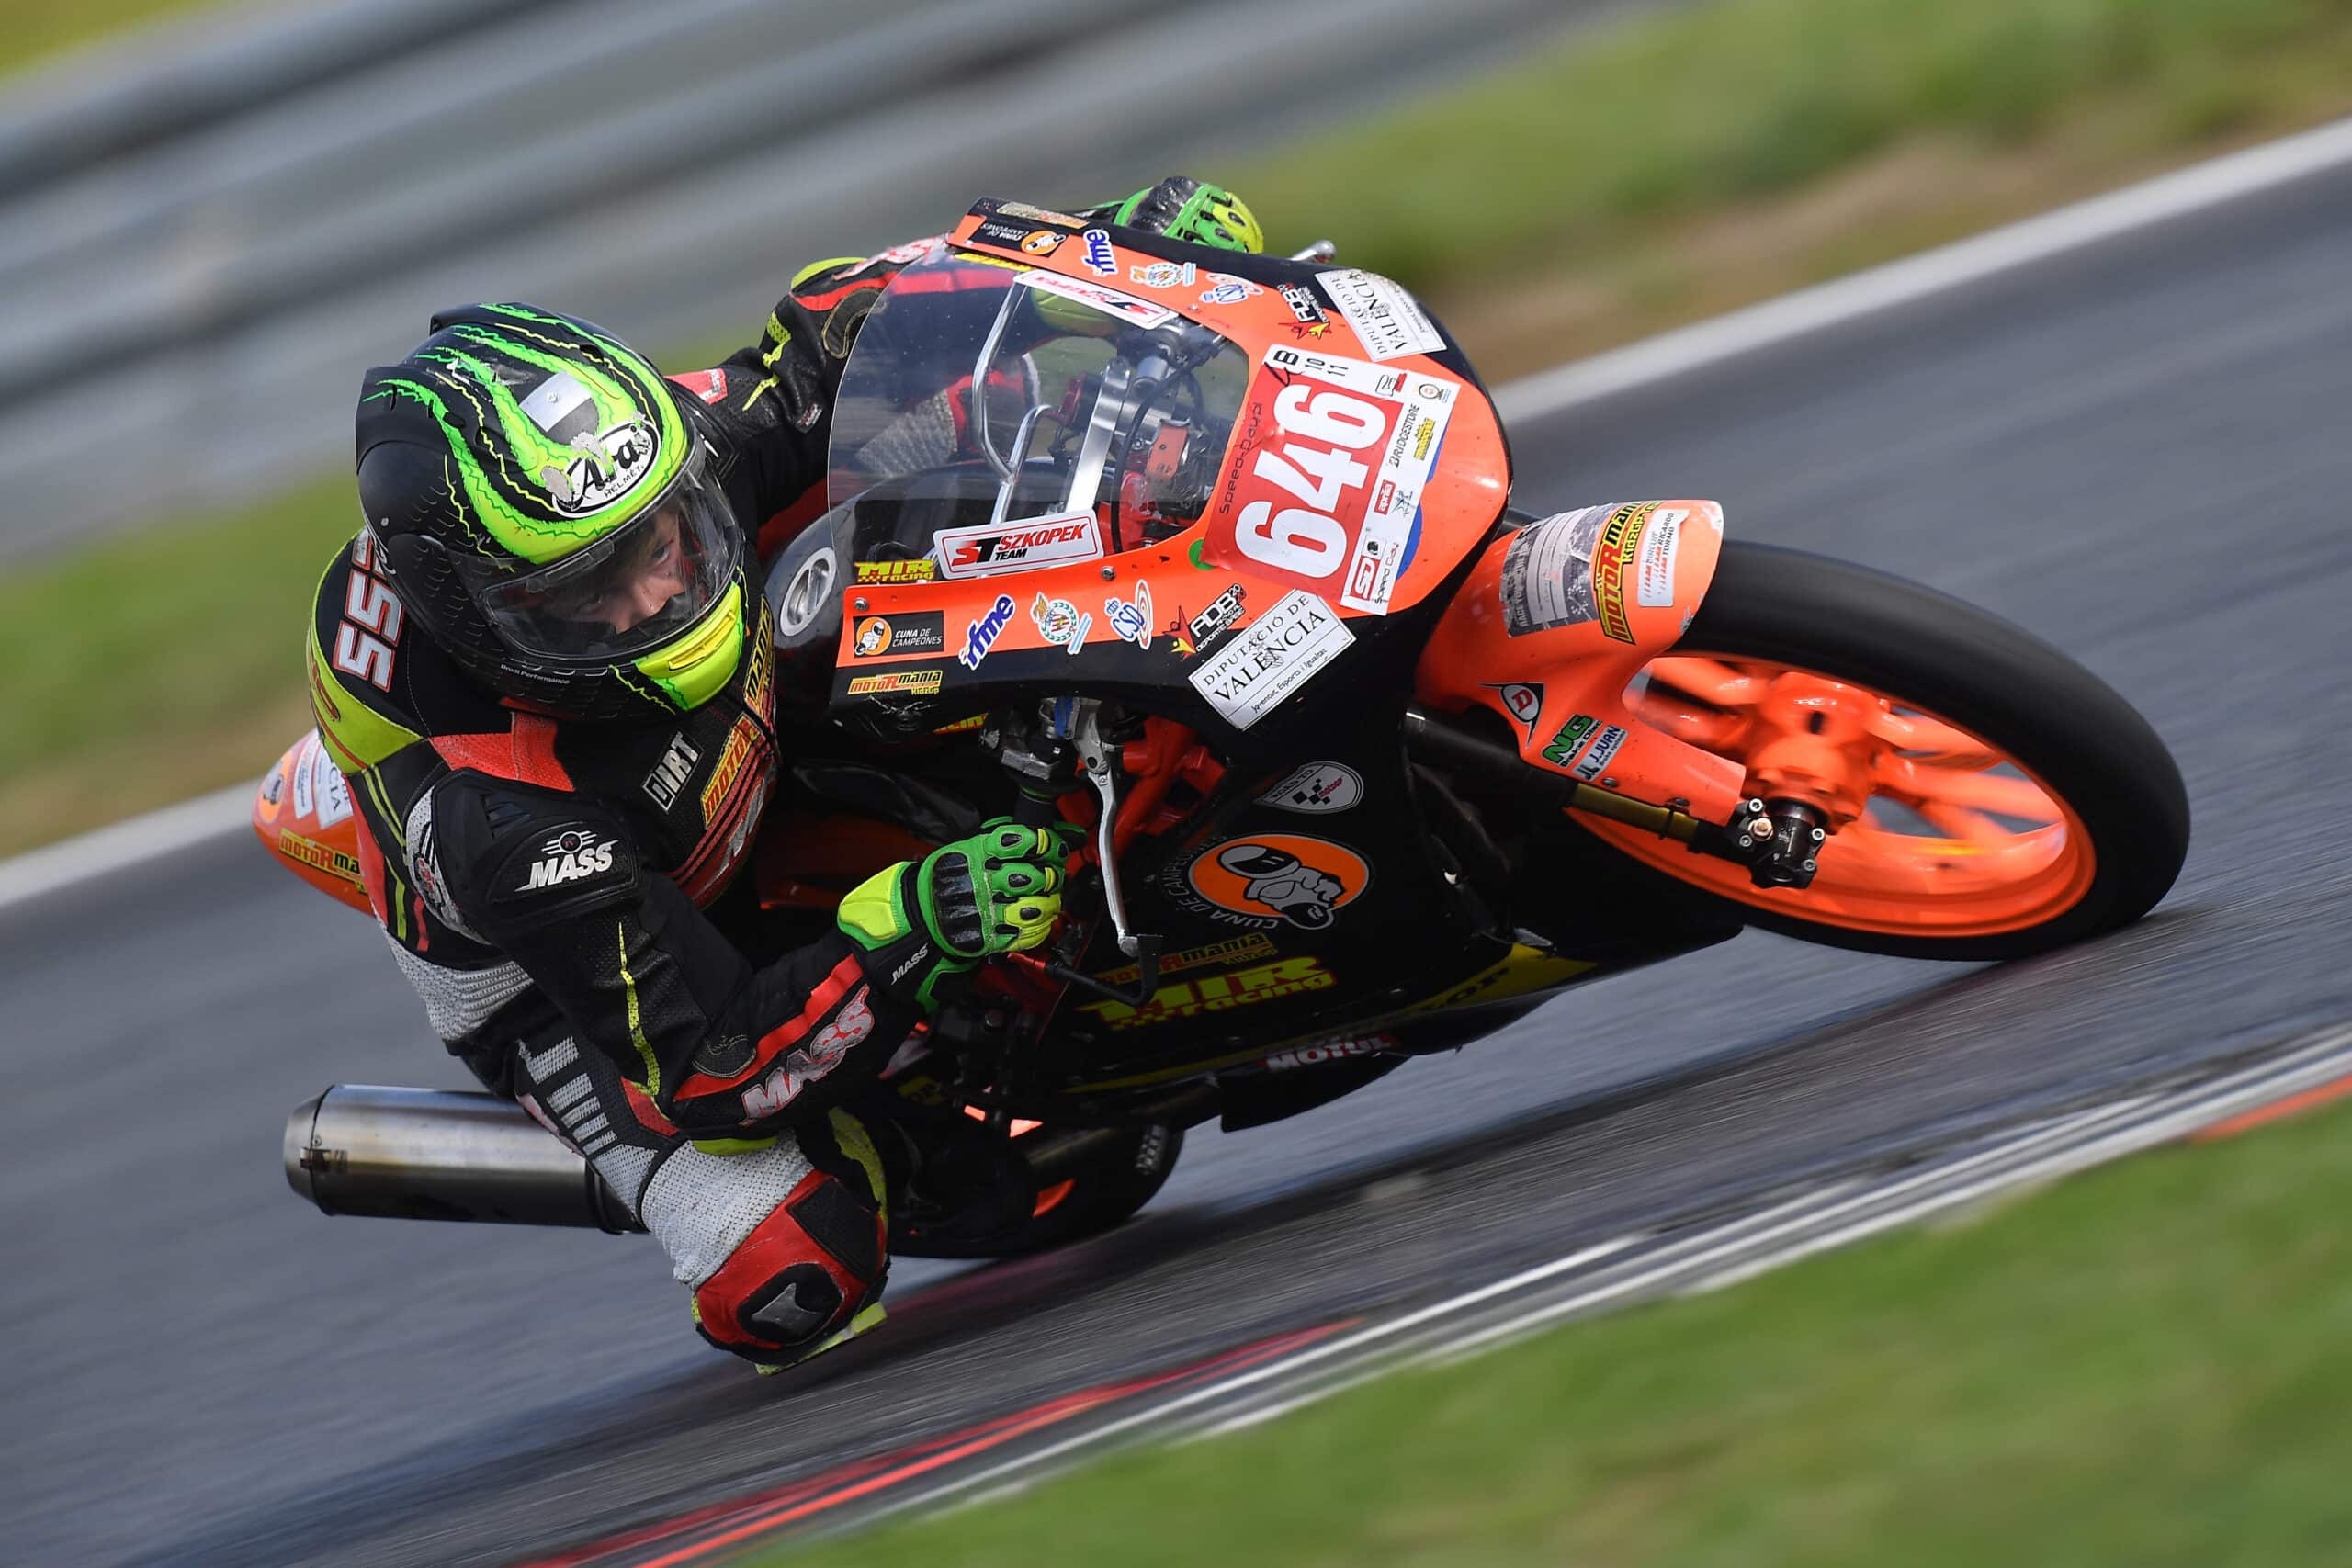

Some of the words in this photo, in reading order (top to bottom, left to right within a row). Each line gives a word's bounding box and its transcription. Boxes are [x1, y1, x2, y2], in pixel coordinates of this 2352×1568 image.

[1273, 349, 1299, 366] B
[1305, 357, 1327, 371] 10
[1327, 363, 1349, 377] 11
[1389, 403, 1420, 468] BRIDGESTONE
[1235, 384, 1386, 579] 646
[998, 523, 1088, 551] SZKOPEK
[1657, 513, 1675, 546] RICARDO
[1662, 526, 1675, 556] TORMO
[854, 558, 934, 576] MIR
[994, 548, 1028, 561] TEAM
[881, 570, 934, 582] racing
[895, 629, 918, 639] CUNA
[919, 627, 932, 637] DE
[967, 596, 1014, 667] rfme
[1191, 596, 1236, 637] ADB
[892, 636, 942, 648] CAMPEONES
[1204, 615, 1284, 687] DIPUTACIÓ
[1287, 595, 1309, 616] DE
[1213, 610, 1327, 701] VALÈNCIA
[1543, 714, 1594, 764] NG
[1589, 726, 1621, 763] J.JUAN
[514, 840, 620, 892] MASS
[1176, 897, 1210, 914] DE
[1209, 910, 1280, 930] CUNA
[891, 943, 928, 985] MASS
[1180, 971, 1336, 1018] racing
[738, 984, 874, 1127] MASS
